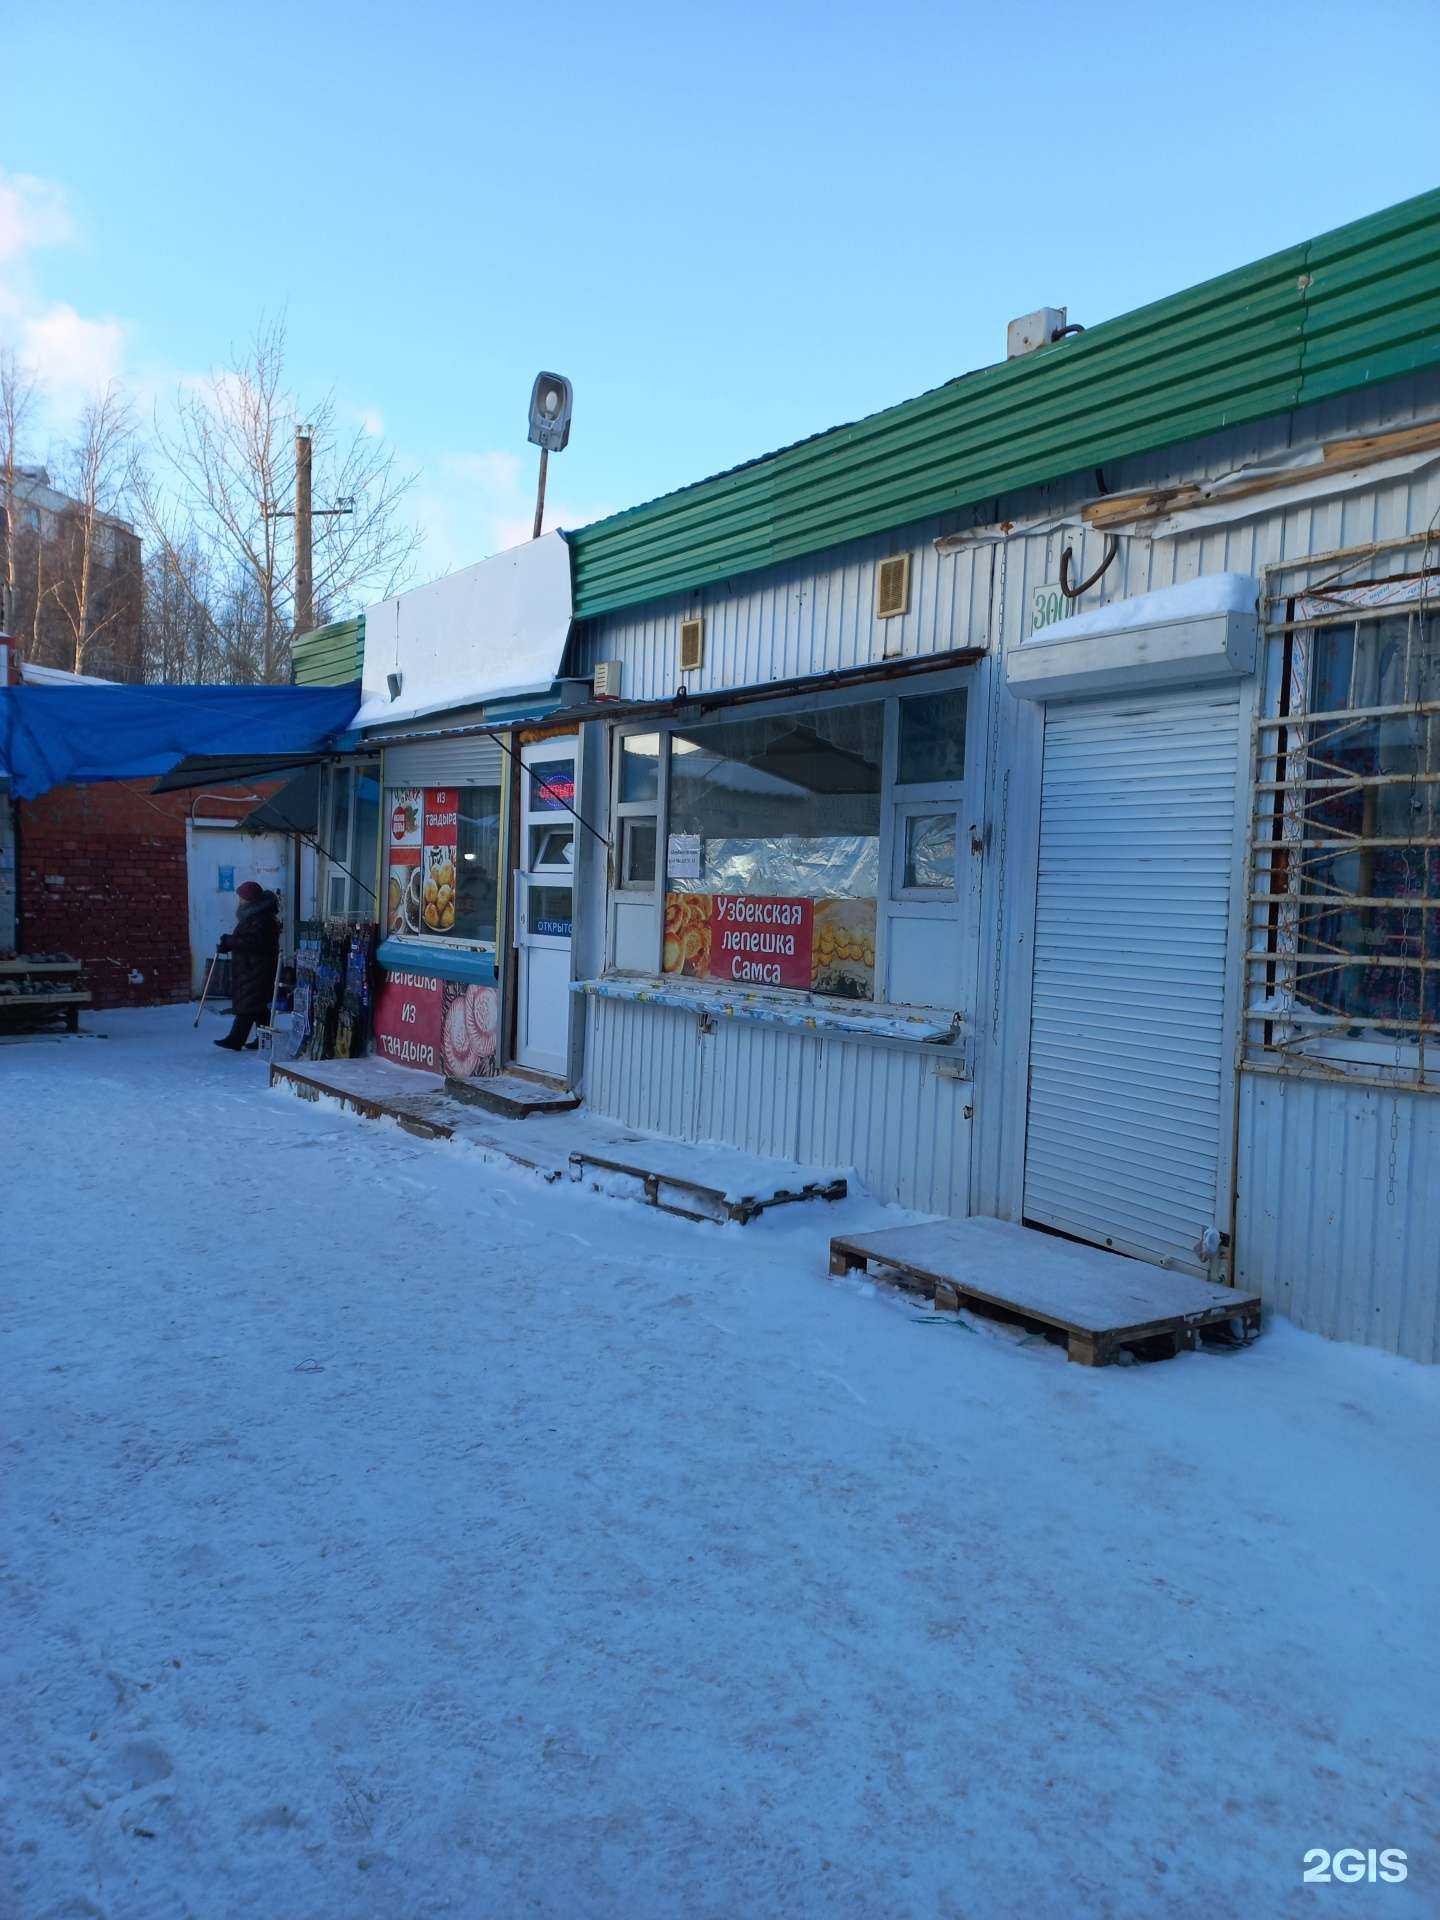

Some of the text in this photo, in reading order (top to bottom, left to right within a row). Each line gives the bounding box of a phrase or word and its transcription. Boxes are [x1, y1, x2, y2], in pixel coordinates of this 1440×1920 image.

[425, 812, 457, 827] тандыра
[717, 897, 802, 925] Узбекская
[721, 931, 795, 955] лепешка
[732, 955, 781, 984] Самса
[380, 1035, 434, 1066] тандыра
